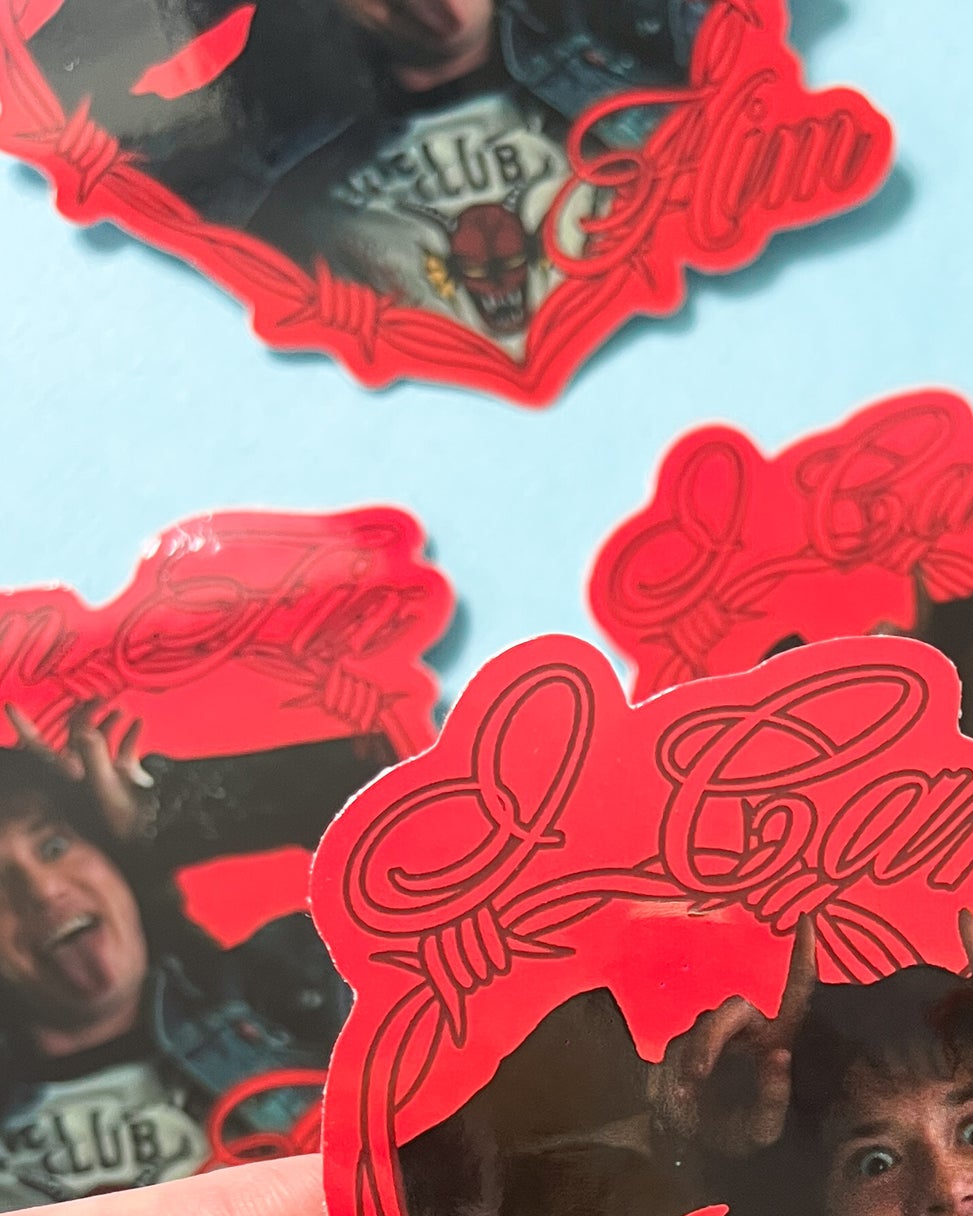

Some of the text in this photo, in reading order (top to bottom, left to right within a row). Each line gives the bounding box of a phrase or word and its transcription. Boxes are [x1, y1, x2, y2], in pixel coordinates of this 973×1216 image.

[413, 143, 522, 200] CLUB
[543, 67, 872, 277] Him
[343, 663, 566, 939] I
[43, 1117, 158, 1174] CLUB
